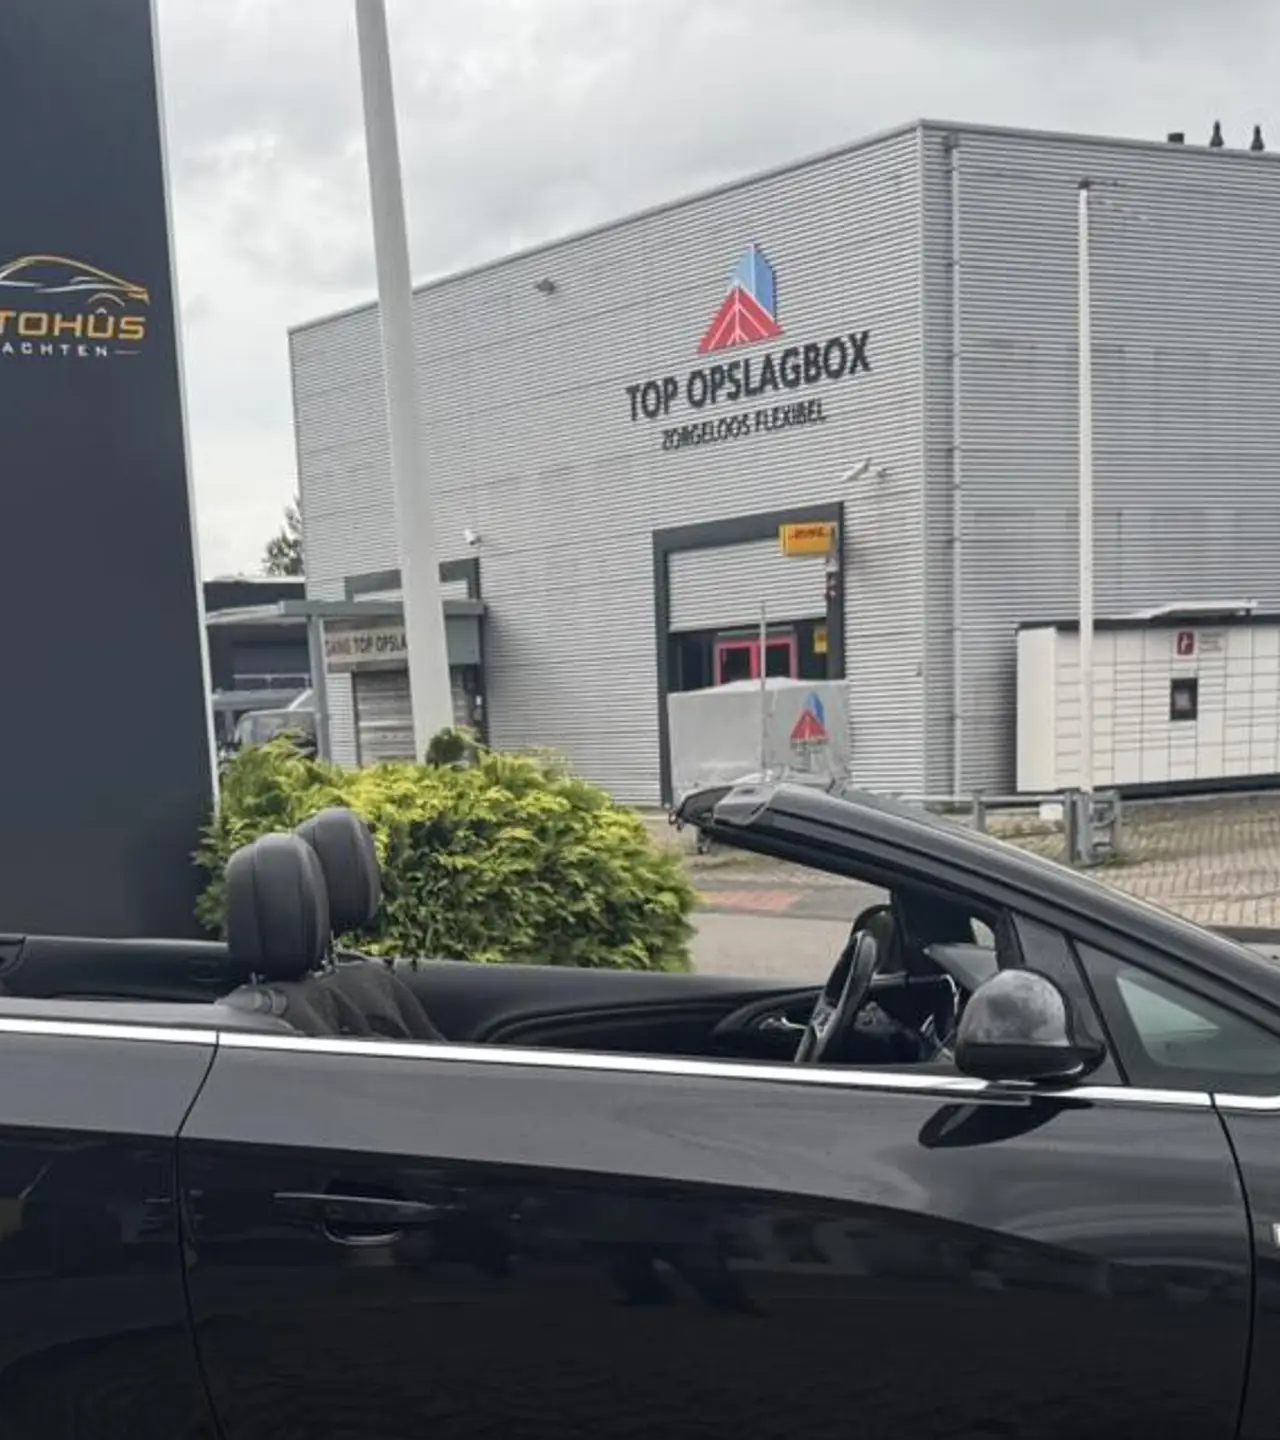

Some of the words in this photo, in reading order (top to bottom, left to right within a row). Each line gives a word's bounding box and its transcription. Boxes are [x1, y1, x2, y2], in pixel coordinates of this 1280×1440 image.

[625, 375, 678, 421] TOP
[686, 330, 871, 408] OPSLAGBOX
[662, 413, 750, 450] ZORGELOOS
[755, 399, 827, 433] FLEXIBEL
